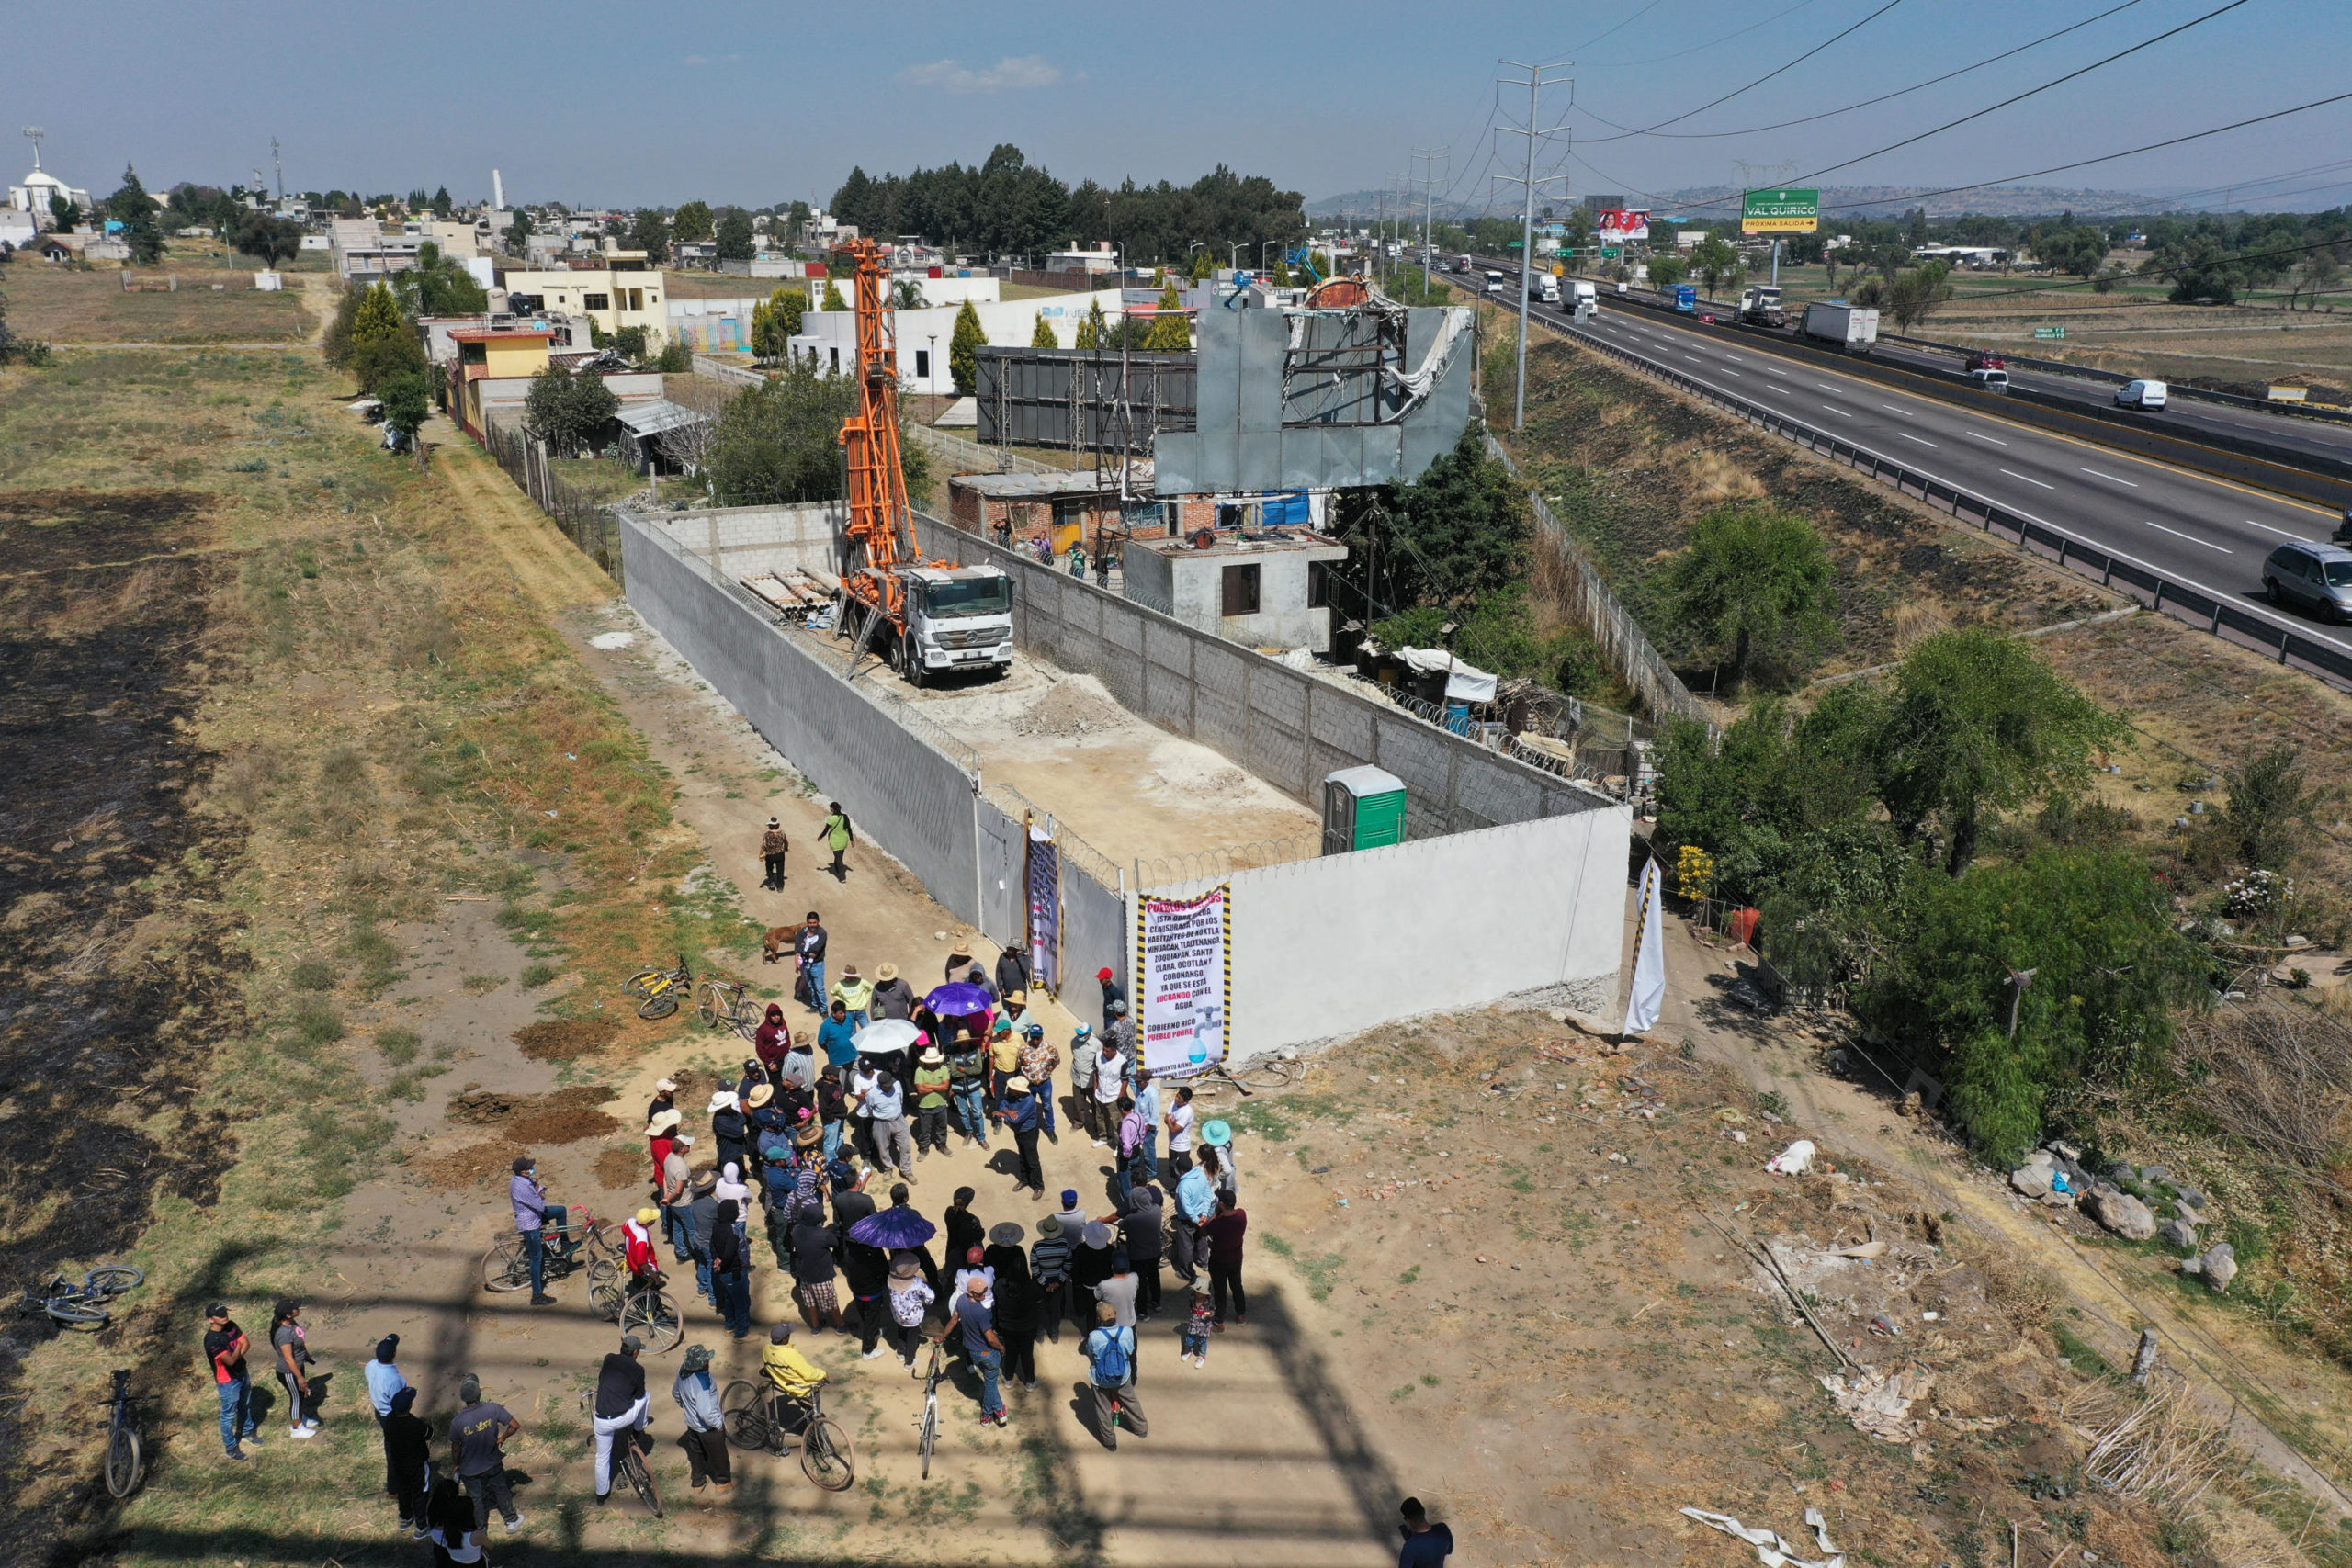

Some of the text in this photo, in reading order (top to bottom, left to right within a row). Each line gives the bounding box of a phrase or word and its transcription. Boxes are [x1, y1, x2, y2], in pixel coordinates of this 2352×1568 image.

[1148, 892, 1221, 913] PUEBLOS UOS
[1158, 914, 1172, 923] ESTA
[1193, 919, 1205, 927] POR
[1206, 917, 1219, 925] LOS
[1148, 932, 1184, 943] HABITANTES
[1193, 948, 1212, 956] SANTA
[1161, 984, 1169, 992] YA
[1170, 982, 1182, 991] QUE
[1183, 980, 1192, 988] SE
[1157, 992, 1190, 1003] LUCRANDO
[1193, 987, 1204, 998] CON
[1148, 1017, 1196, 1032] GOBIERNO RICO
[1148, 1028, 1193, 1042] PUEBLO POBRE
[1178, 1061, 1192, 1069] AJENO
[1179, 1067, 1198, 1077] PARTIDO
